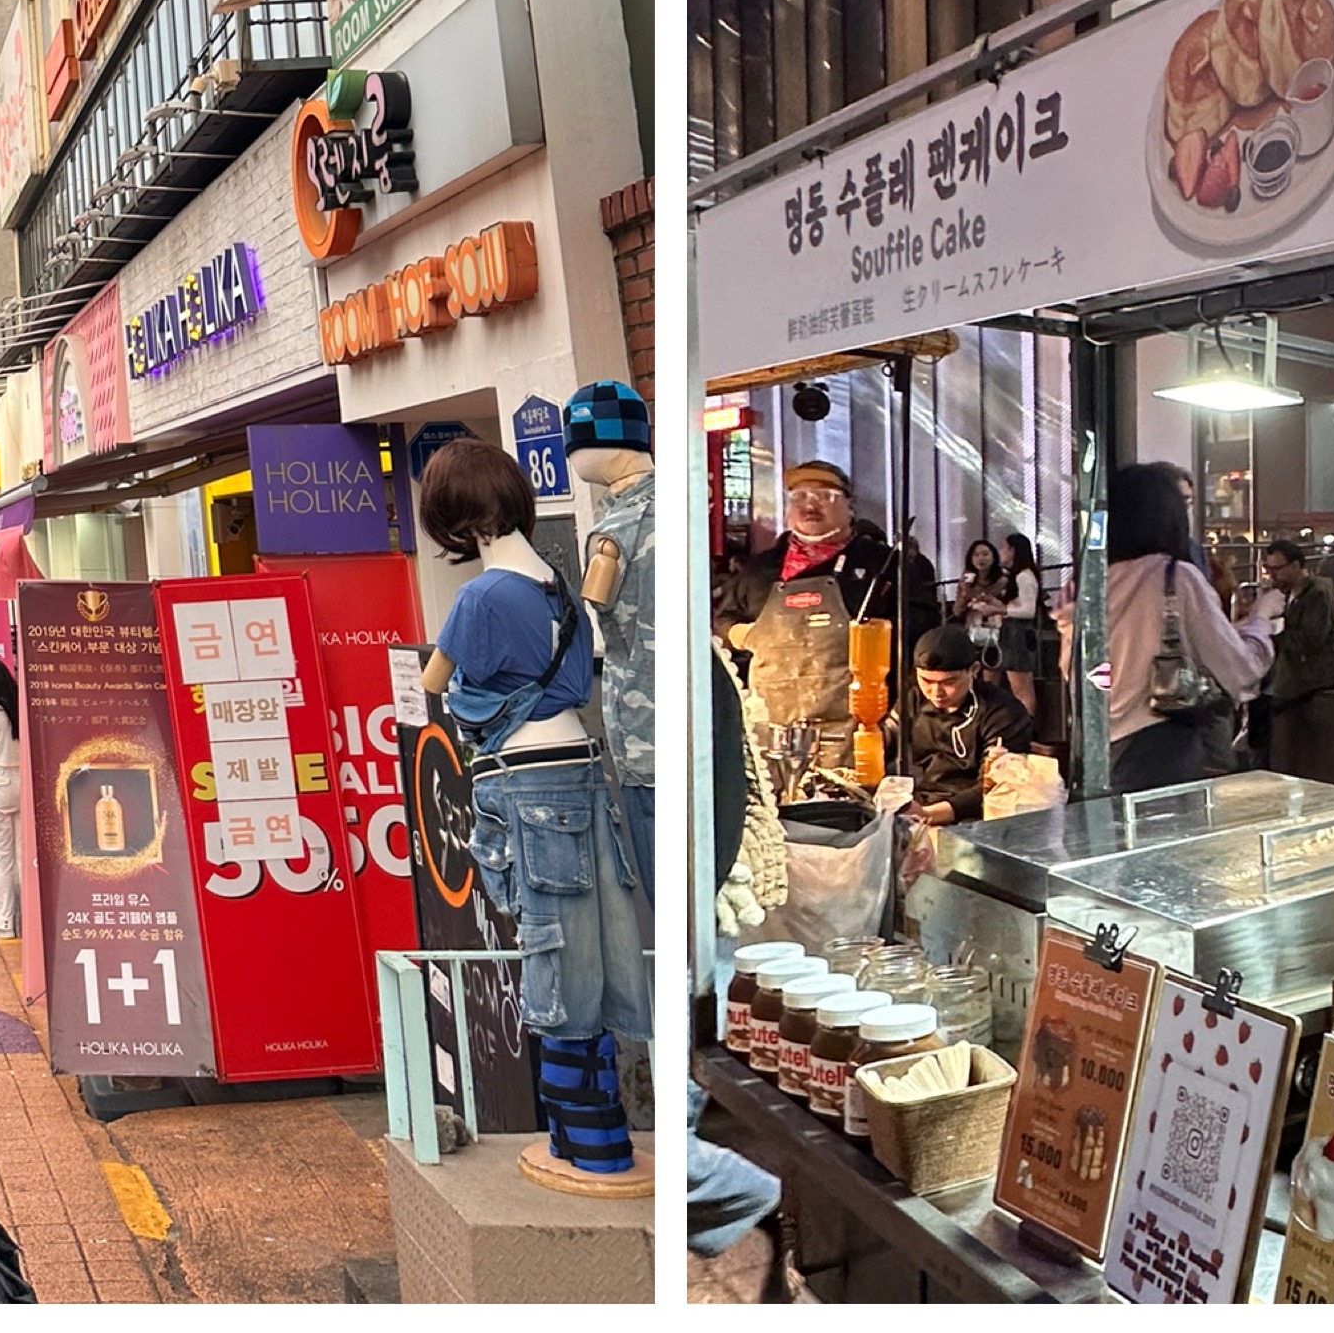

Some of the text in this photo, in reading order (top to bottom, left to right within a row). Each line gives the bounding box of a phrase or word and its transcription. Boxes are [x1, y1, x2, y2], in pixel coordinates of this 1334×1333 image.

[334, 8, 371, 59] ROOM
[785, 91, 1067, 255] 명동 수플레 팬케이크
[851, 212, 985, 283] Souffle Cake
[902, 247, 1066, 314] 生クリームスフレケーキ
[320, 222, 512, 365] ROOM HOF SOJU
[125, 242, 259, 379] HOLIKA HOLIKA
[266, 461, 373, 485] HOLIKA
[528, 448, 556, 490] 86
[269, 489, 377, 514] HOLIKA
[28, 625, 115, 638] 2019년 대한민국
[188, 619, 280, 661] 금연
[346, 631, 401, 645] HOLIKA
[115, 642, 137, 653] 대상
[30, 682, 50, 690] 2019
[75, 682, 101, 691] Beauty
[103, 682, 133, 690] Awards
[212, 697, 279, 723] 매장앞
[228, 815, 293, 845] 금연
[91, 894, 150, 906] 프라임 유스
[68, 912, 151, 924] 24K 골드 리페어
[61, 929, 184, 941] 순도 99.9% 24K 순금 함유
[74, 949, 181, 1025] 1+1
[80, 1041, 183, 1056] HOLIKA HOLIKA
[266, 1039, 328, 1051] HOLIKA HOLIKA
